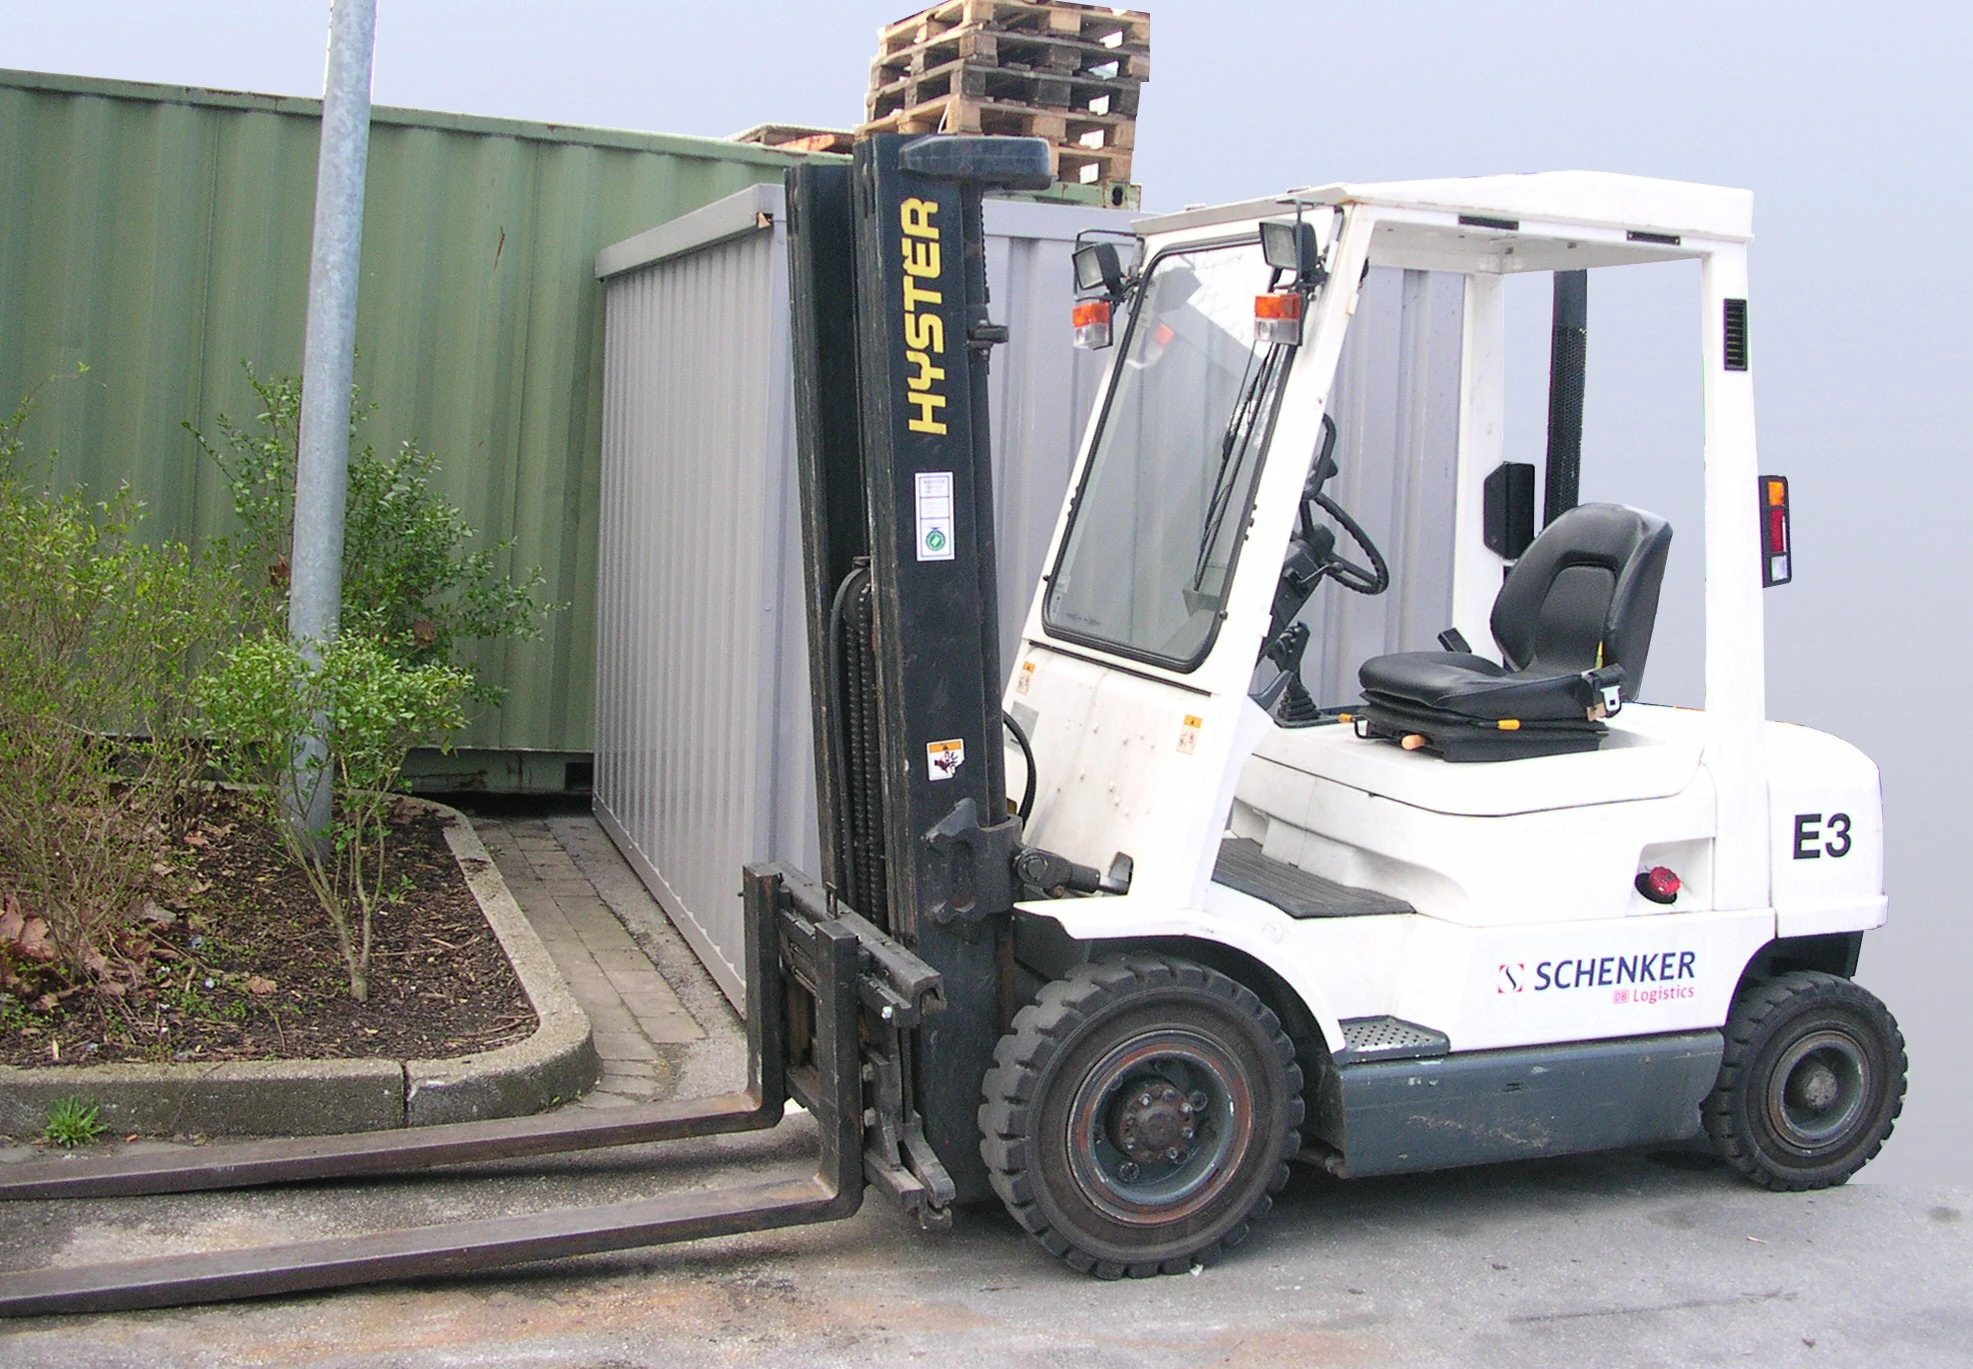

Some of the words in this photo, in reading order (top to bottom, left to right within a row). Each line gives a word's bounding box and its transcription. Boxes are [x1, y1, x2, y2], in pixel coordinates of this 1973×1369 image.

[901, 197, 947, 435] HYSTER
[1793, 812, 1851, 860] E3
[1534, 951, 1696, 991] SCHENKER
[1633, 985, 1695, 1004] Logistics
